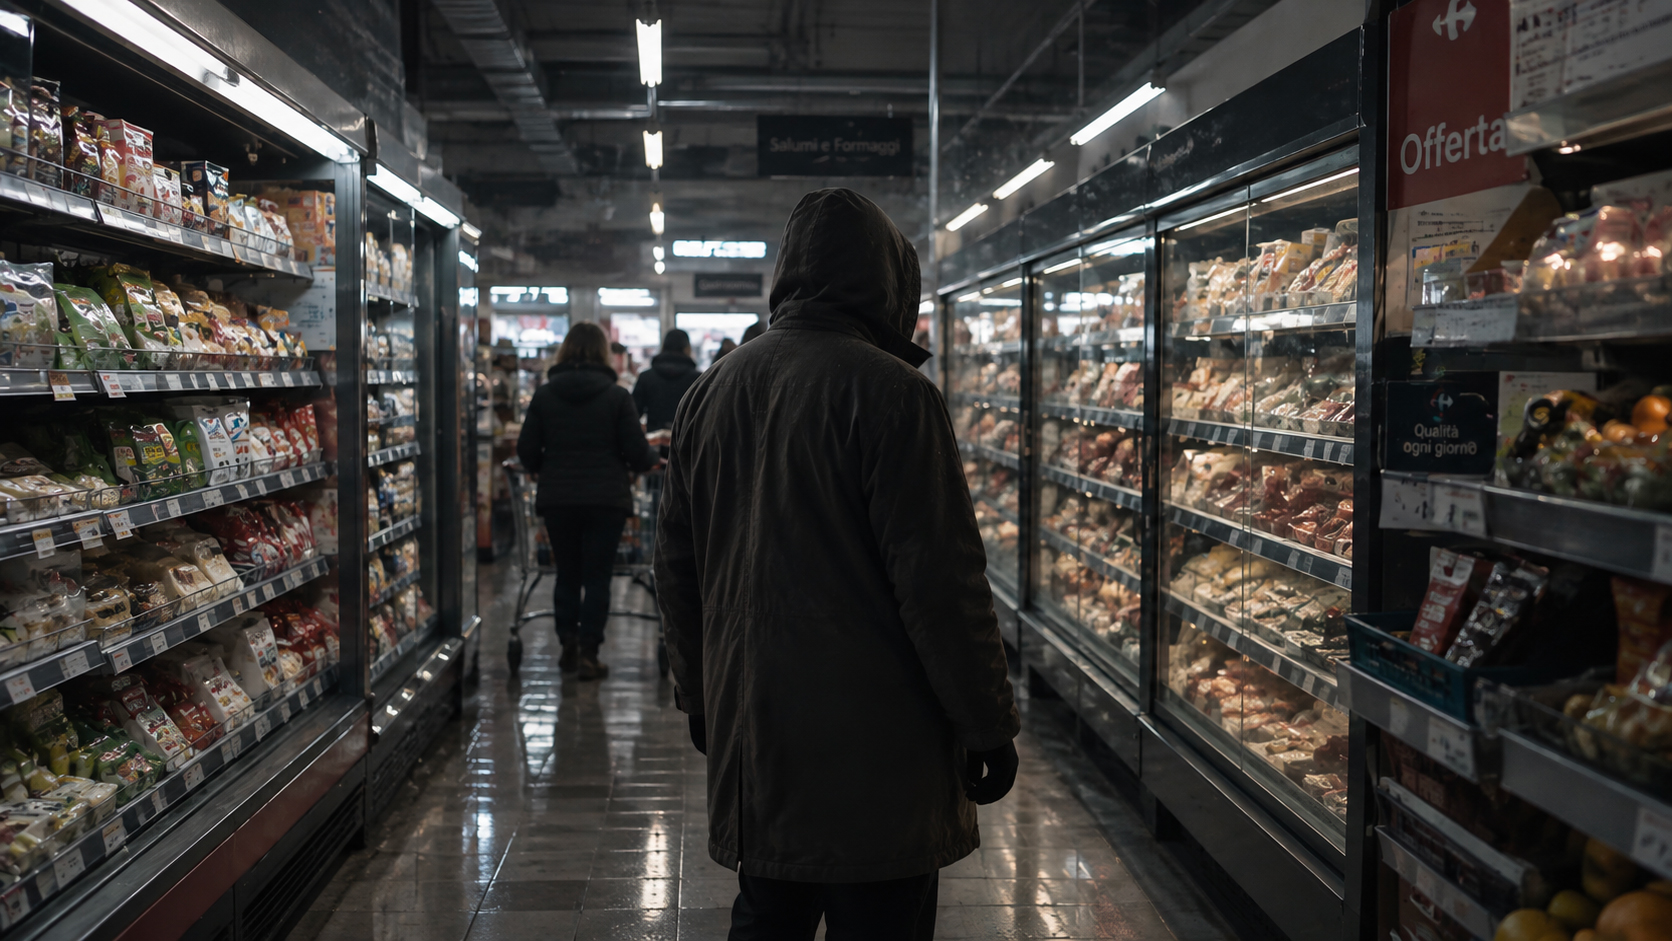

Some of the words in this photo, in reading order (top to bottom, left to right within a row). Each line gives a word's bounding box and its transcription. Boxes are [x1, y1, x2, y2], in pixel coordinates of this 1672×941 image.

[769, 136, 818, 153] Salumi
[820, 140, 831, 153] e
[833, 136, 901, 157] Formaggi
[1400, 114, 1506, 175] Offerta
[1403, 440, 1432, 457] ogni
